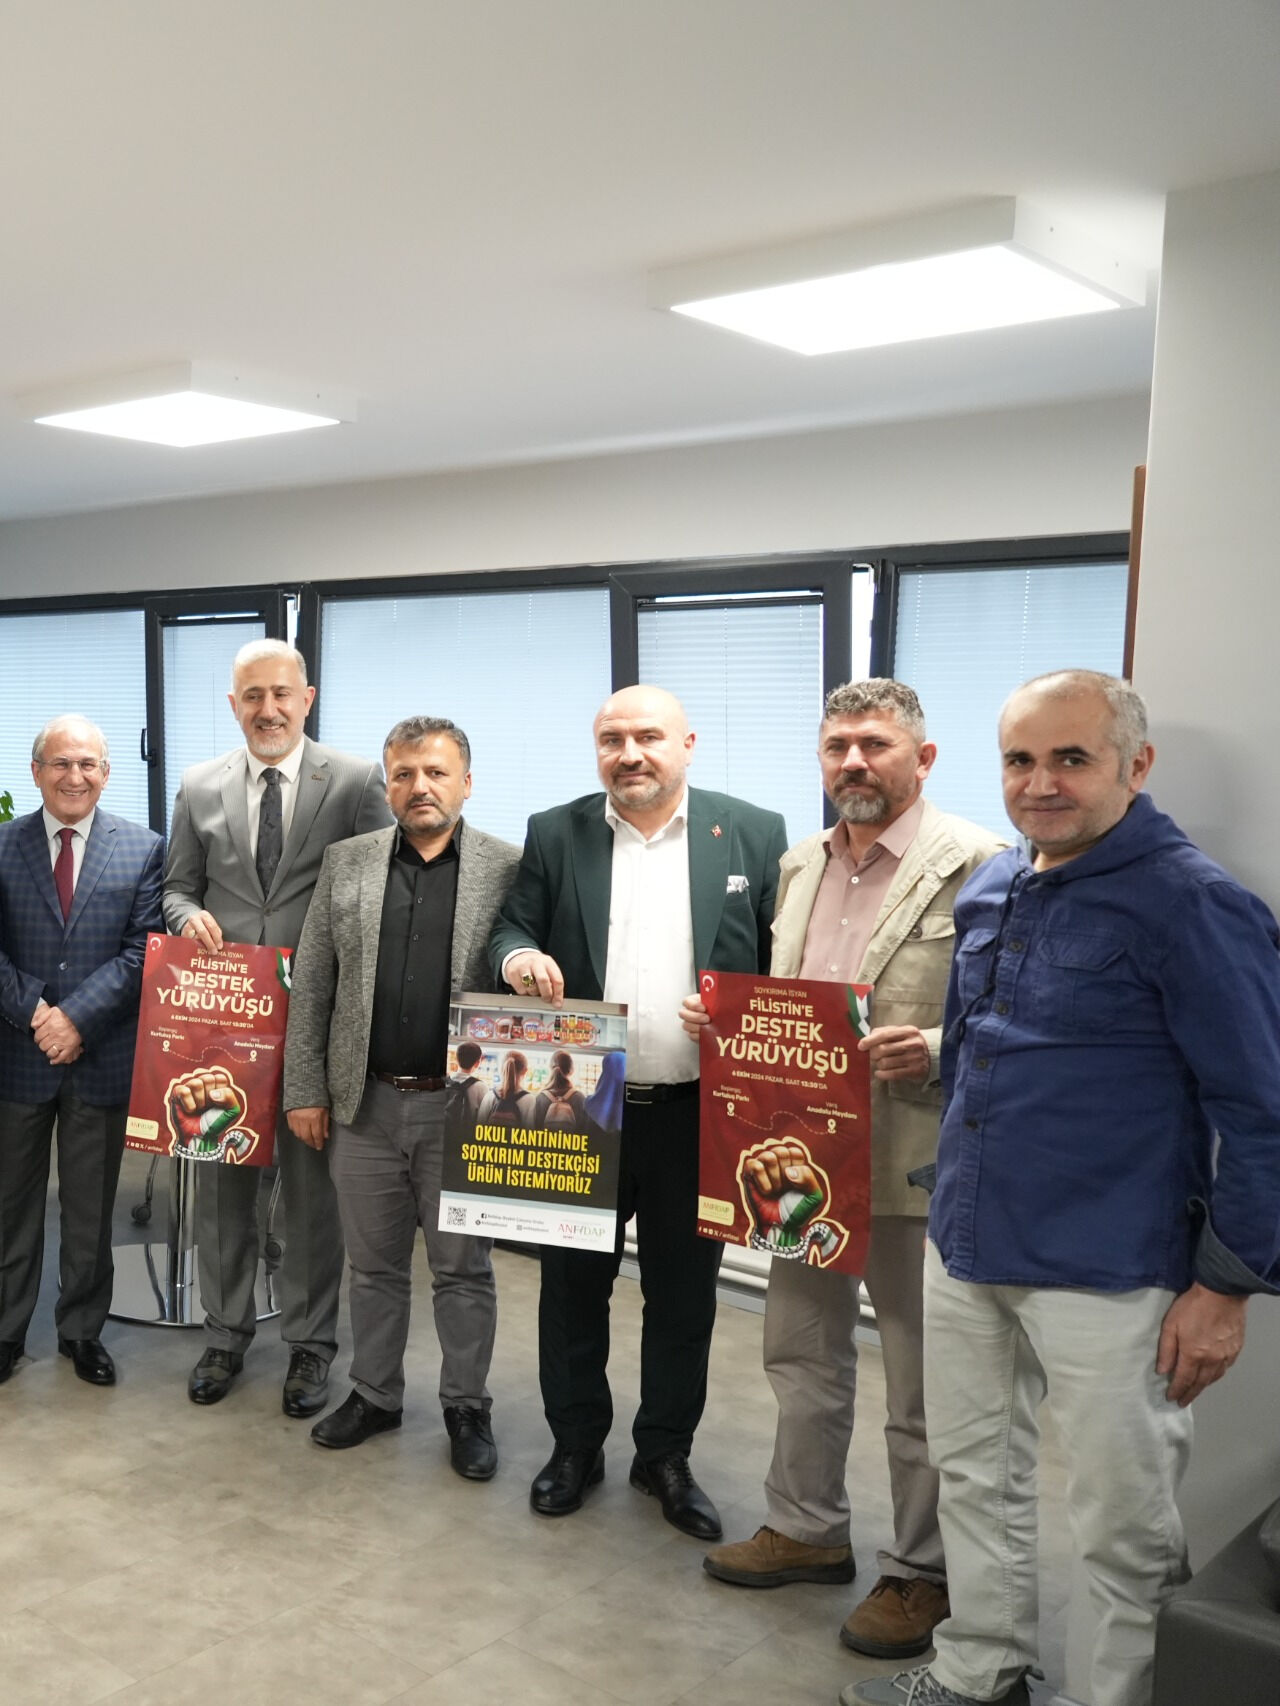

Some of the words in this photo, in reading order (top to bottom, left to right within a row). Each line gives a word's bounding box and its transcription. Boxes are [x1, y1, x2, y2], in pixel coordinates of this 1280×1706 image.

[190, 956, 248, 974] FİLİSTİN'E
[180, 970, 255, 992] DESTEK
[156, 986, 274, 1020] YÜRÜYÜŞÜ
[750, 997, 813, 1018] FİLİSTİN'E
[742, 1014, 823, 1042] DESTEK
[716, 1033, 848, 1078] YÜRÜYÜŞÜ
[475, 1125, 507, 1144] OKUL
[511, 1127, 588, 1152] KANTİNİNDE
[462, 1144, 524, 1166] SOYKIRIM
[528, 1151, 600, 1176] DESTEKÇİSİ
[467, 1162, 503, 1184] ÜRÜN
[507, 1167, 592, 1194] İSTEMİYORUZ
